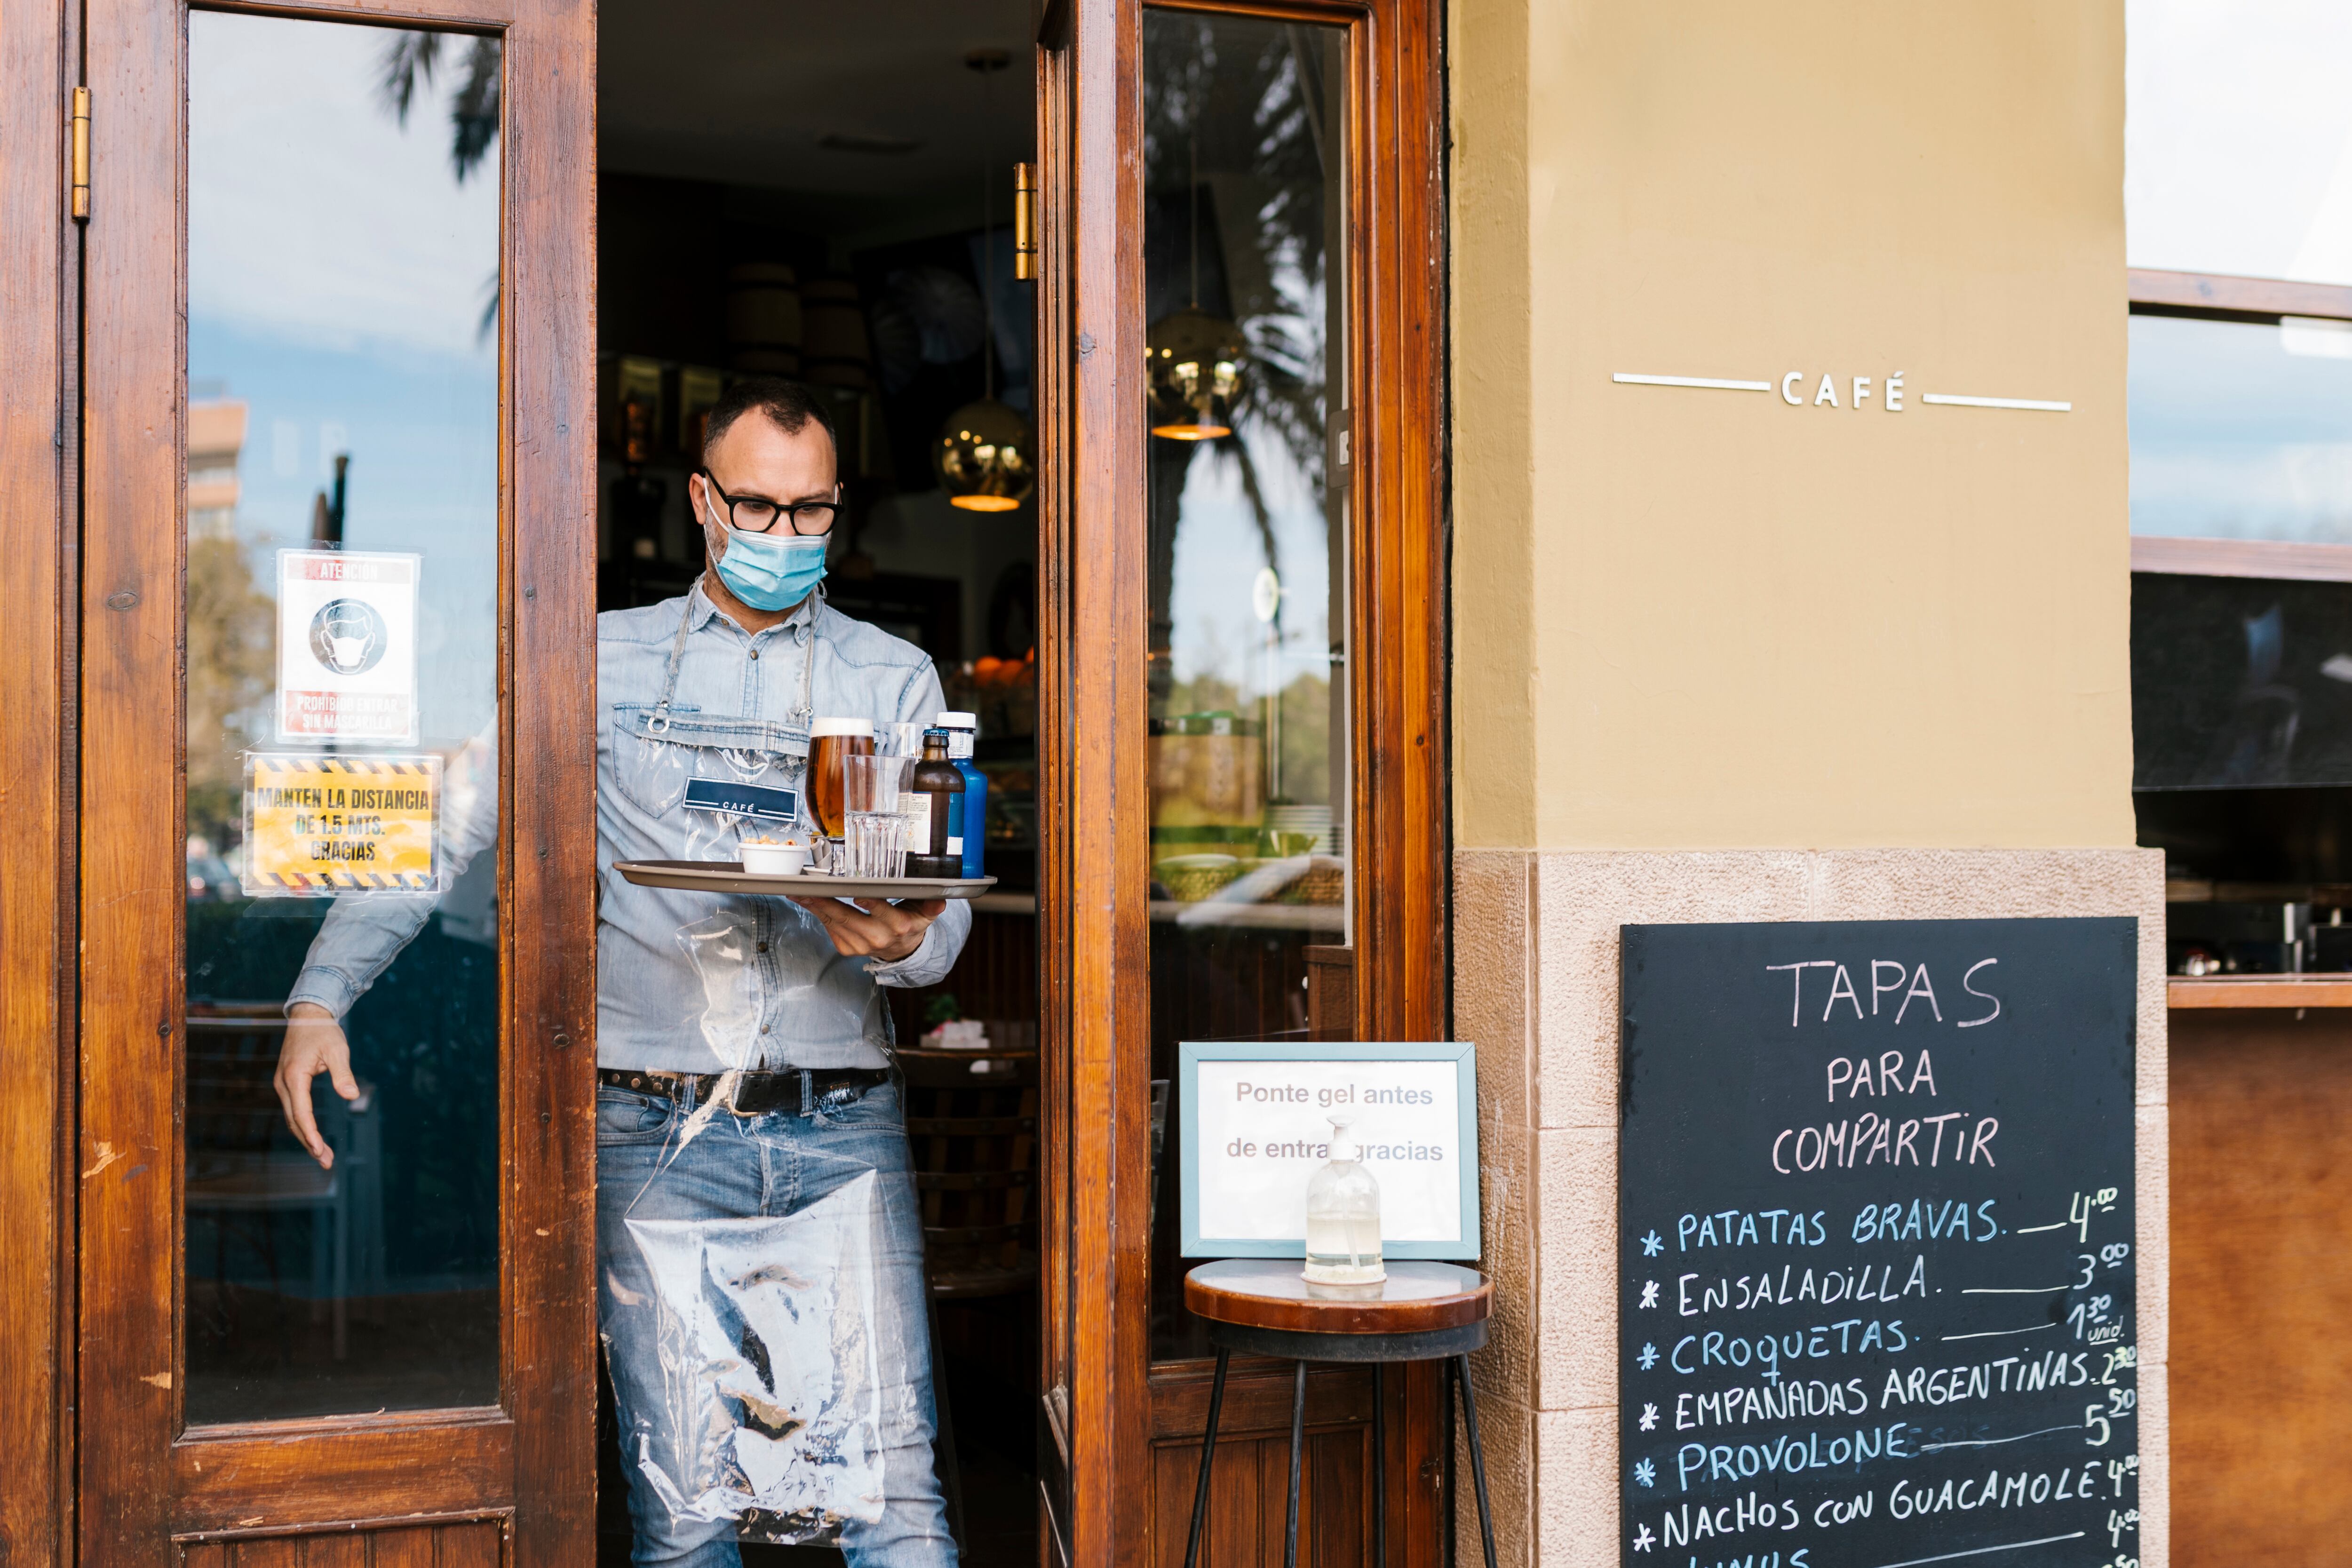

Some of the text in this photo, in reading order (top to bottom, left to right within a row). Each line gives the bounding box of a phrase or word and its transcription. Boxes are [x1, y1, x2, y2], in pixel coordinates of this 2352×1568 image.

[1781, 371, 1904, 412] CAFÉ
[298, 696, 397, 713] PROHIBIDO ENTRAR
[302, 714, 392, 729] SIN MASCARILLA
[257, 788, 429, 810] MANTEN LA DISTANCIA
[723, 801, 754, 812] CAFÉ
[296, 814, 385, 835] DE 1.5 MTS.
[310, 841, 375, 861] GRACIAS
[1766, 958, 2000, 1027] TAPAS
[1828, 1050, 1937, 1102] PARA
[1237, 1082, 1433, 1107] Ponte gel antes
[1227, 1138, 1256, 1157] de
[1355, 1141, 1443, 1163] gracias
[1678, 1210, 1826, 1251] PATATAS
[1677, 1423, 1908, 1491] PROVOLONE
[1664, 1491, 1799, 1547] NACHOS
[1814, 1491, 1873, 1528] CON
